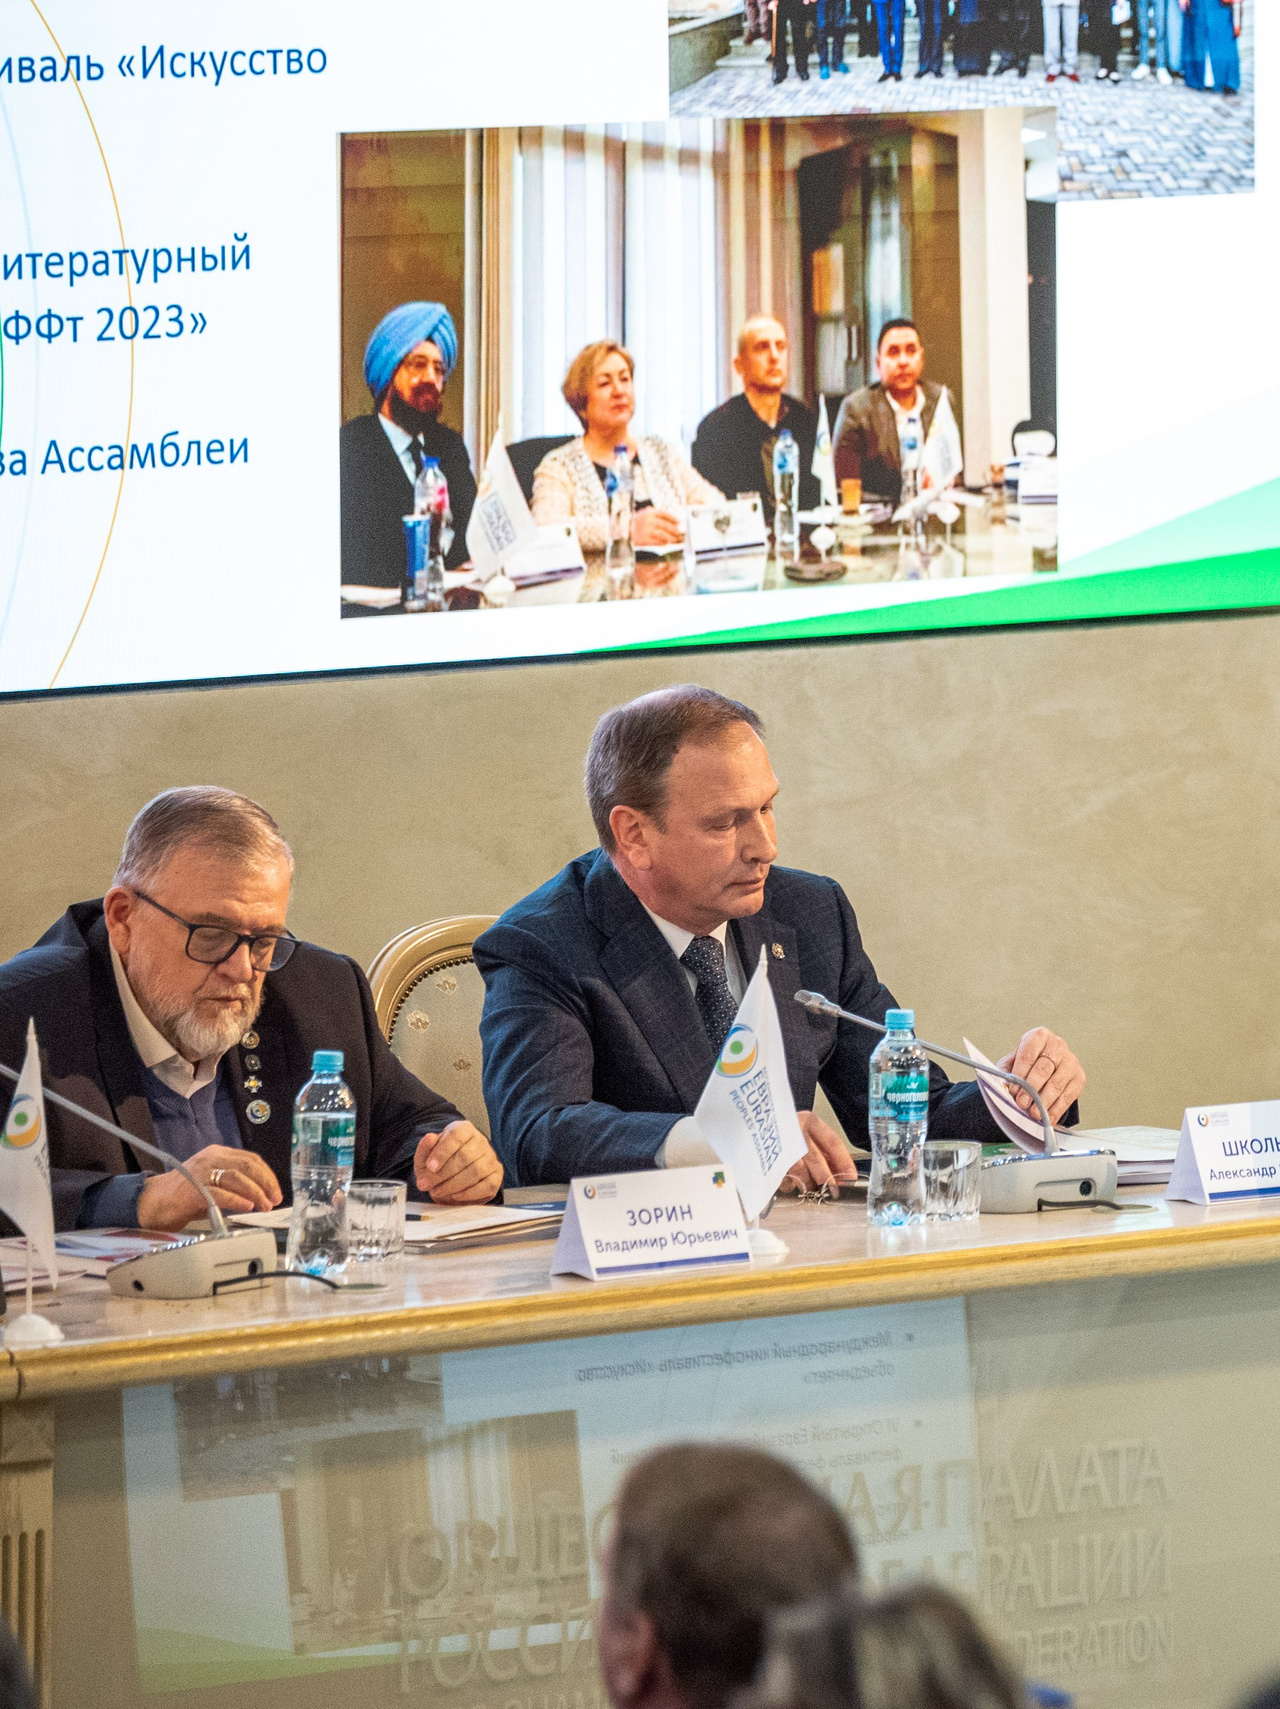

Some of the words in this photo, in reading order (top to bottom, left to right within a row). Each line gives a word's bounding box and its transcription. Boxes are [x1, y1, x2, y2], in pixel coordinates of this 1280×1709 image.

[118, 45, 328, 87] «Искусство
[3, 232, 251, 287] итературный
[96, 303, 208, 342] 2023»
[41, 430, 249, 475] Ассамблеи
[740, 1079, 772, 1172] EURASIAN
[1209, 1165, 1277, 1181] Александр
[626, 1204, 694, 1227] ЗОРИН
[594, 1235, 668, 1254] Владимир
[670, 1229, 739, 1248] Юрьевич
